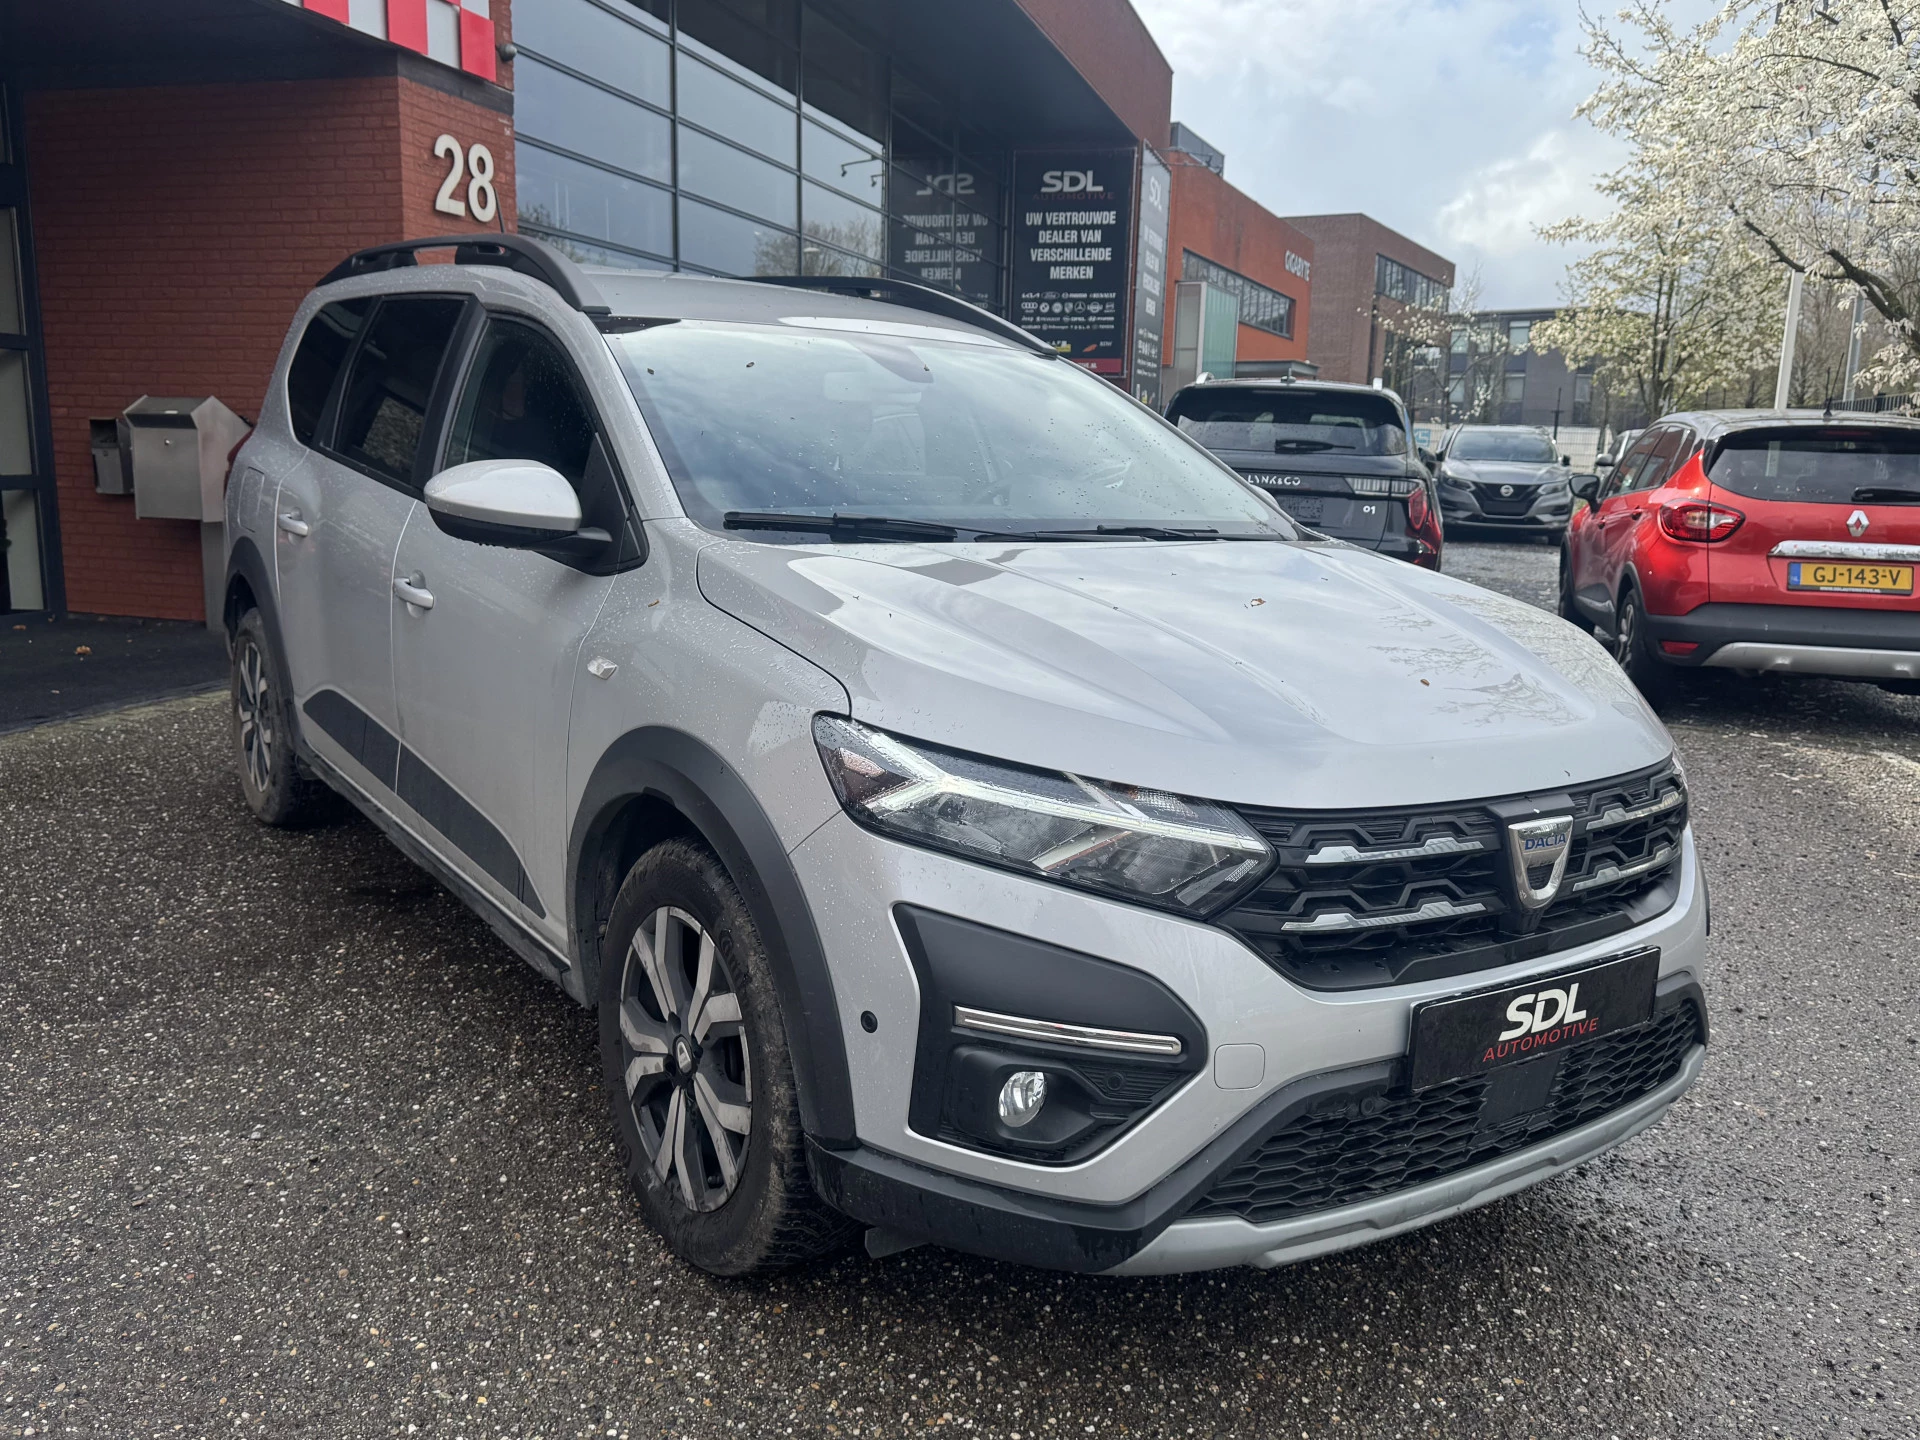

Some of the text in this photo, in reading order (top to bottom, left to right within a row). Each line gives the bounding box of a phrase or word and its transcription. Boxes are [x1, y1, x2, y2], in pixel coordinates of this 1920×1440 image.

[434, 134, 497, 223] 28
[1040, 170, 1104, 193] SDL
[1032, 192, 1116, 200] AUTOMOTIVE
[1025, 211, 1117, 226] UW VERTROUWDE
[1038, 229, 1102, 244] DEALER VAN
[1030, 248, 1112, 262] VERSCHILLENDE
[1050, 266, 1094, 280] MERKEN
[1363, 505, 1376, 514] 01
[1813, 566, 1901, 586] GJ-143-V
[1524, 832, 1567, 851] DACIA
[1498, 983, 1587, 1042] SDL
[1482, 1017, 1599, 1063] AUTOMOTIVE
